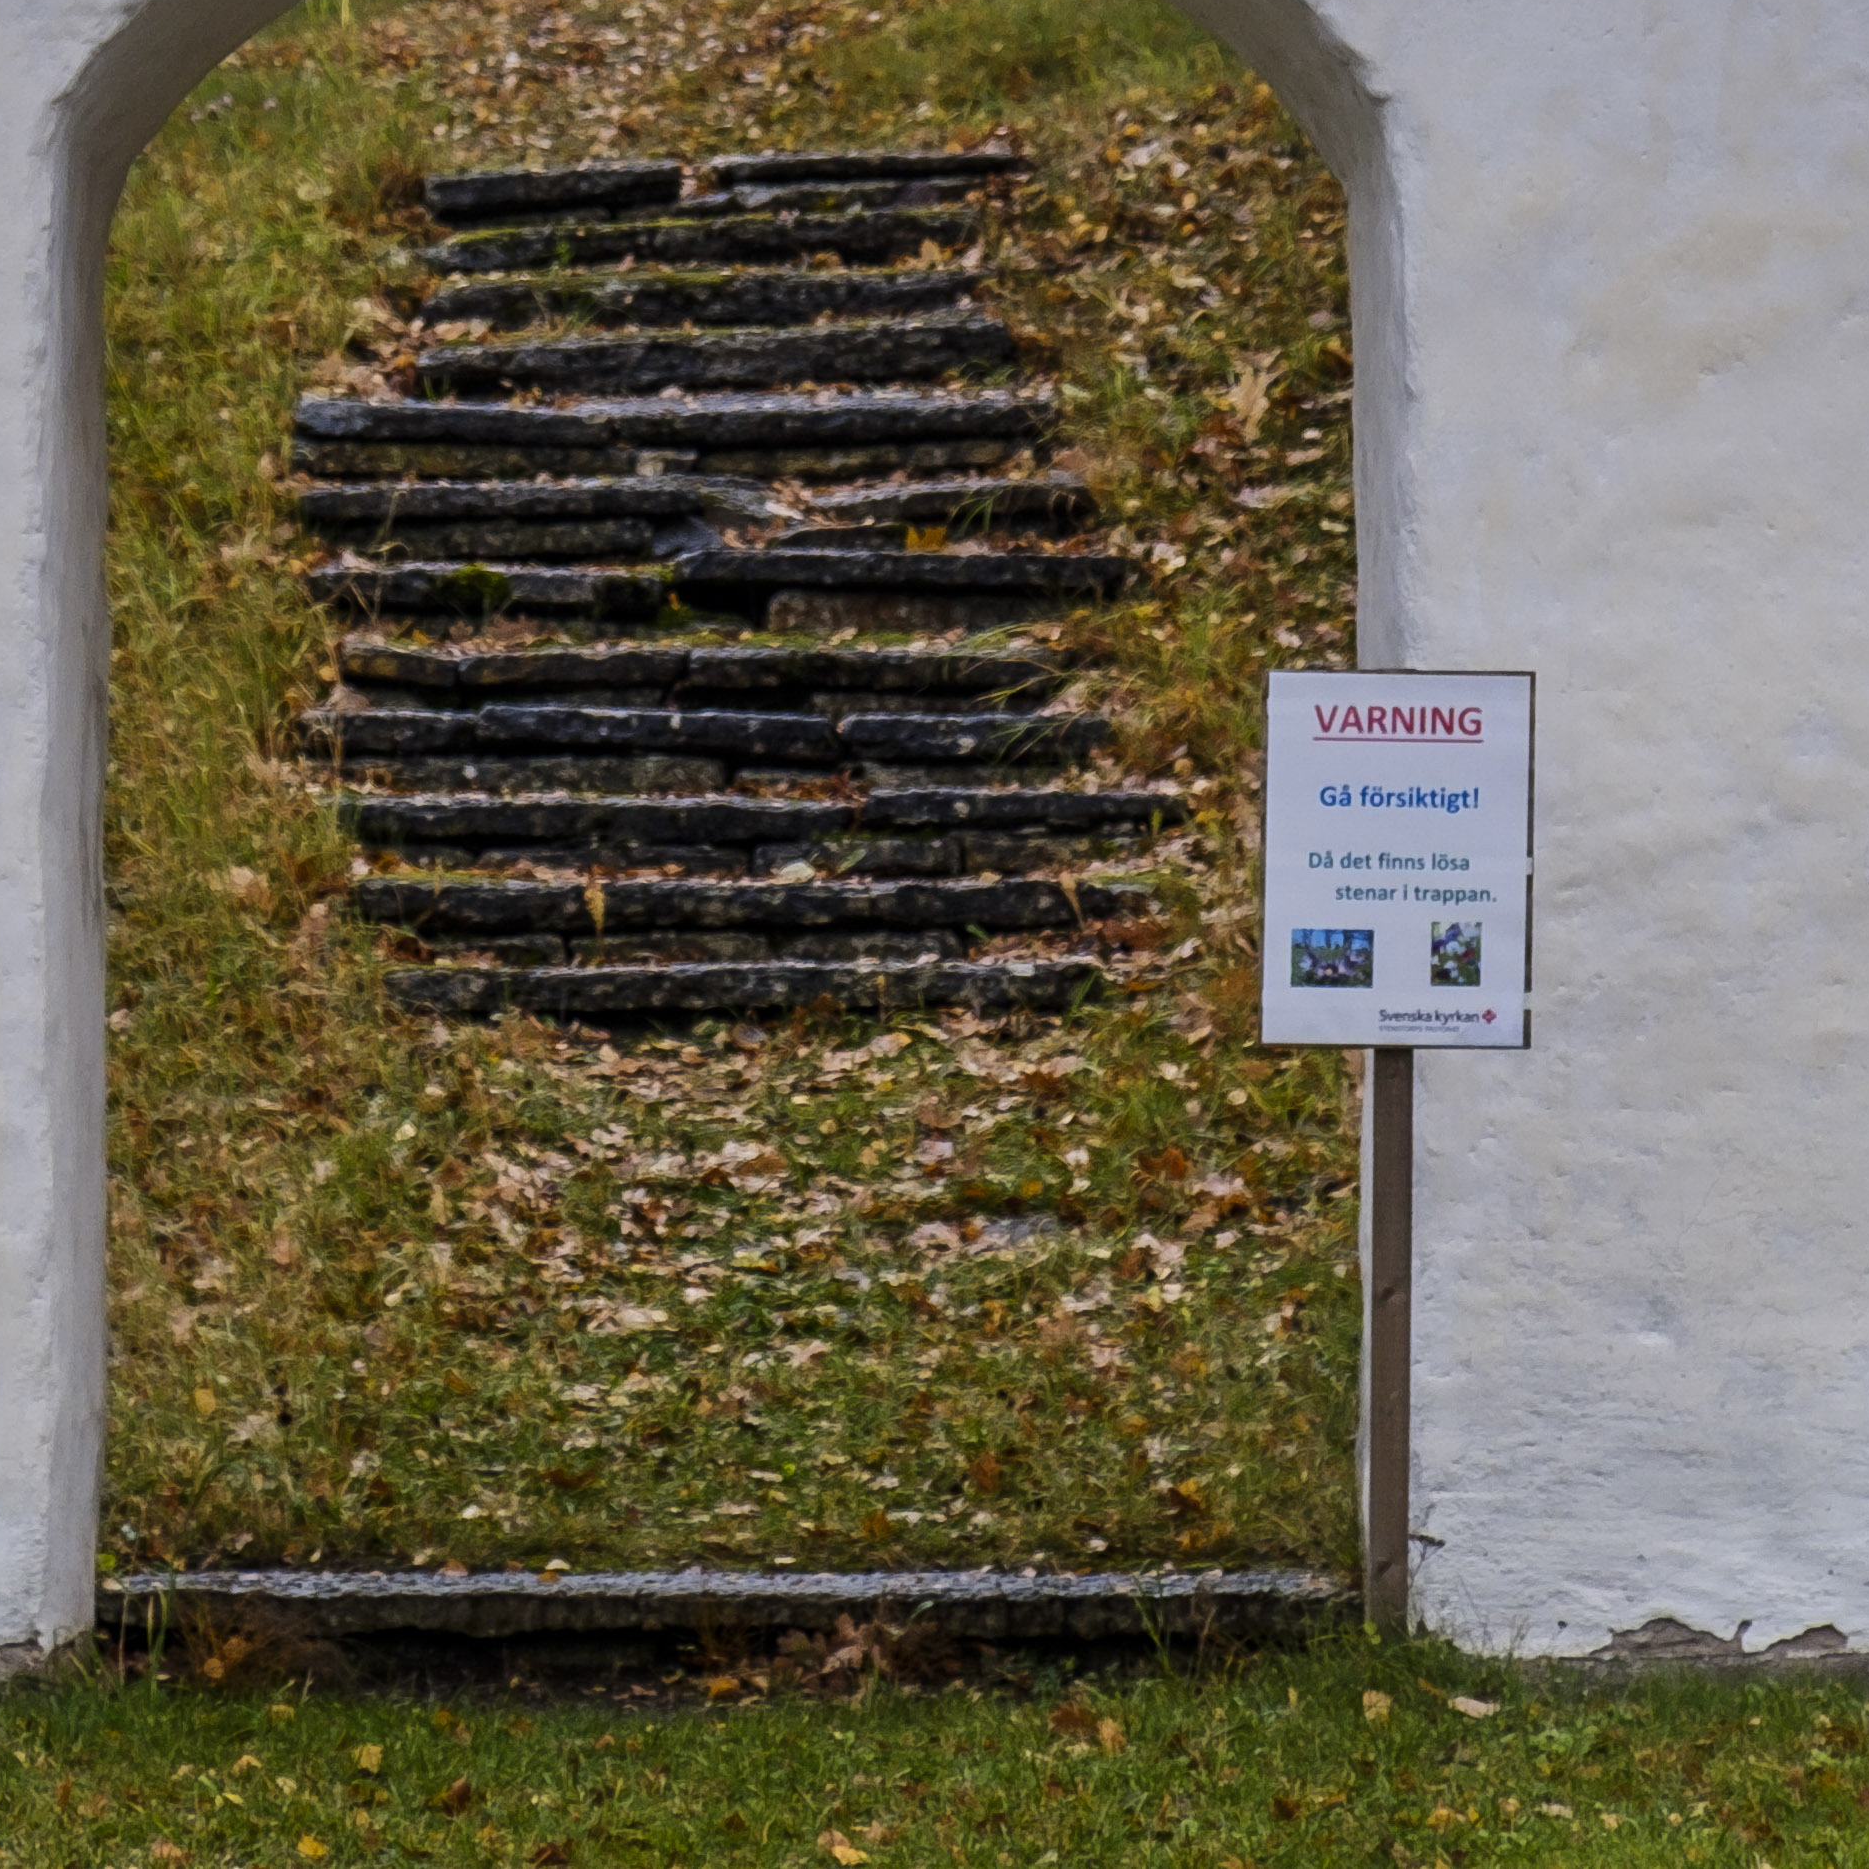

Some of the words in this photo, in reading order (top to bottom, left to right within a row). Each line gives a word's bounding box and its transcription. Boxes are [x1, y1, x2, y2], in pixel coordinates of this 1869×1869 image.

[1314, 705, 1483, 736] VARNING
[1319, 784, 1352, 808] Gå
[1360, 785, 1479, 813] försiktigt!
[1308, 850, 1334, 869] Då
[1340, 851, 1372, 869] det
[1378, 852, 1425, 871] finns
[1431, 852, 1470, 871] lösa
[1335, 885, 1398, 901] stenar
[1414, 886, 1498, 906] trappan.
[1379, 1009, 1432, 1023] Svenska
[1434, 1009, 1479, 1026] kyrkan
